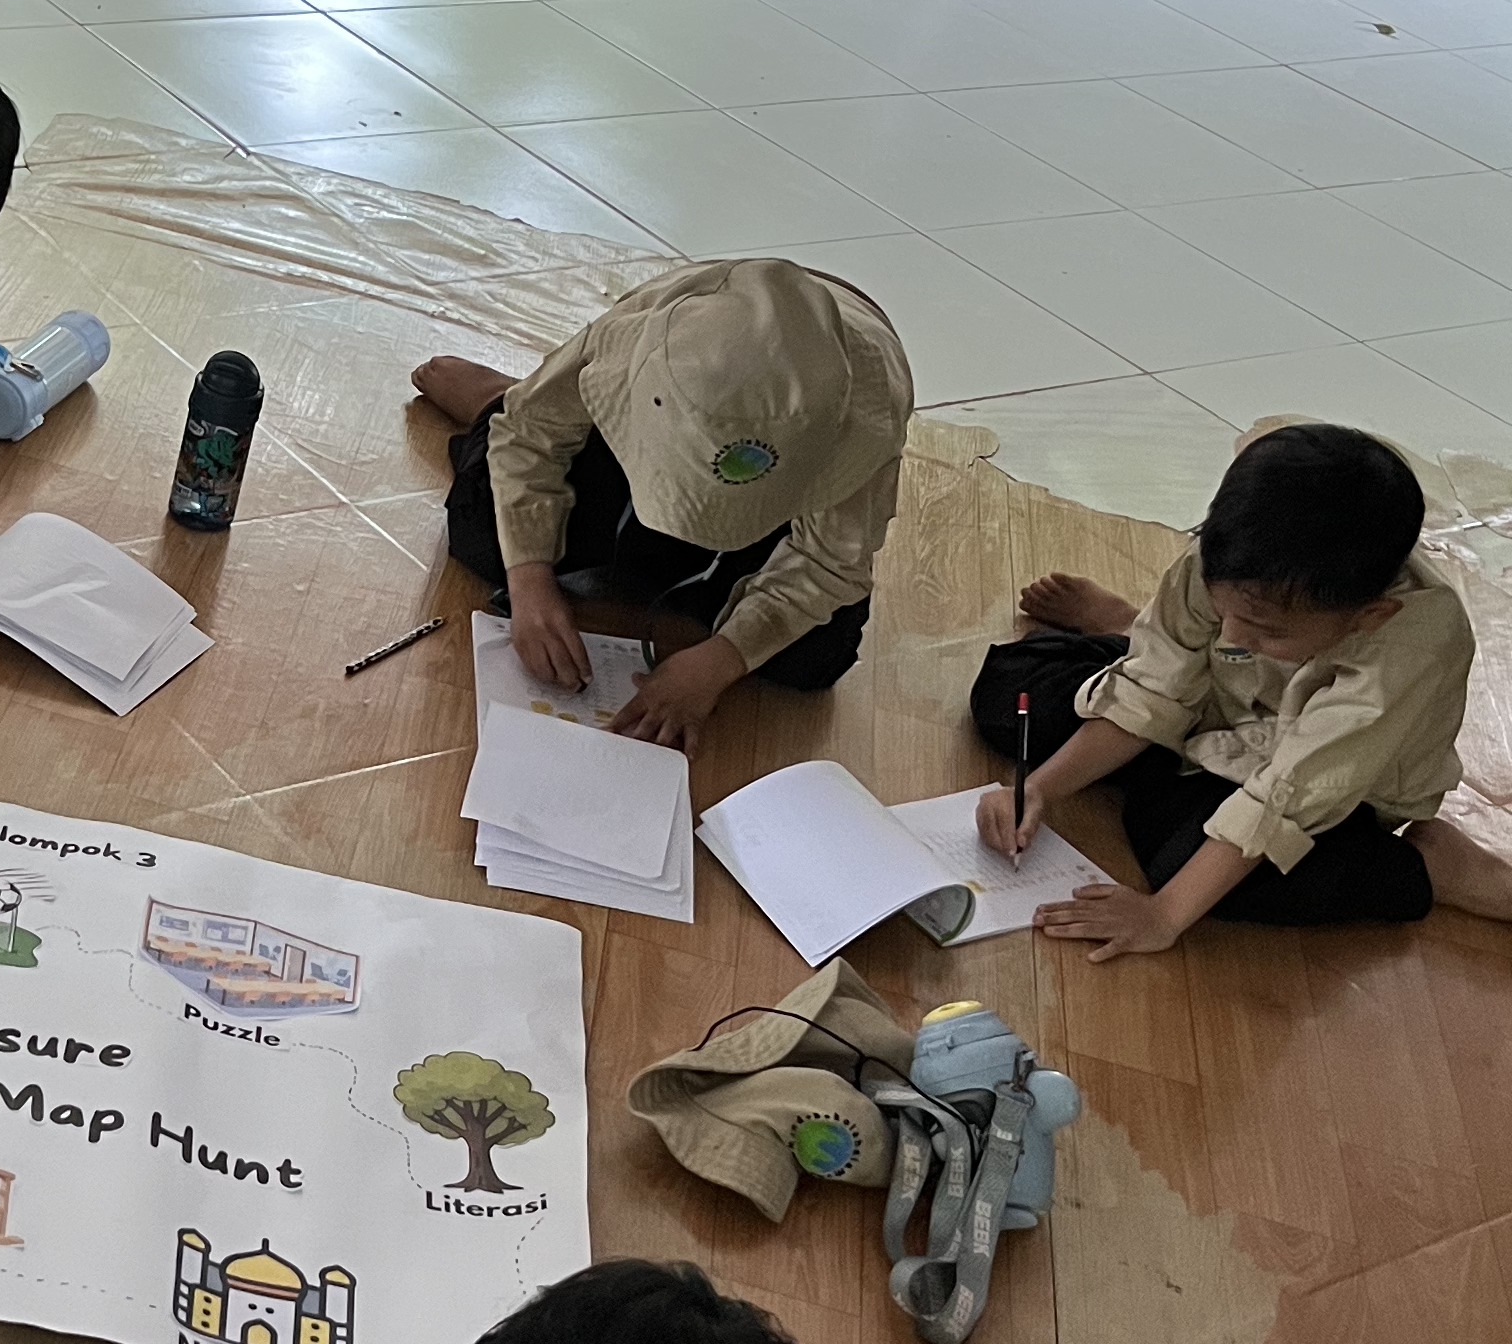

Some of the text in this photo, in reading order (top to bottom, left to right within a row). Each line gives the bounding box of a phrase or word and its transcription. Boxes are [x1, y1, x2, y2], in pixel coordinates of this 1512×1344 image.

[136, 852, 157, 868] 3
[184, 1004, 281, 1047] Puzzle
[150, 1111, 303, 1189] Hunt
[426, 1189, 548, 1218] Literasi
